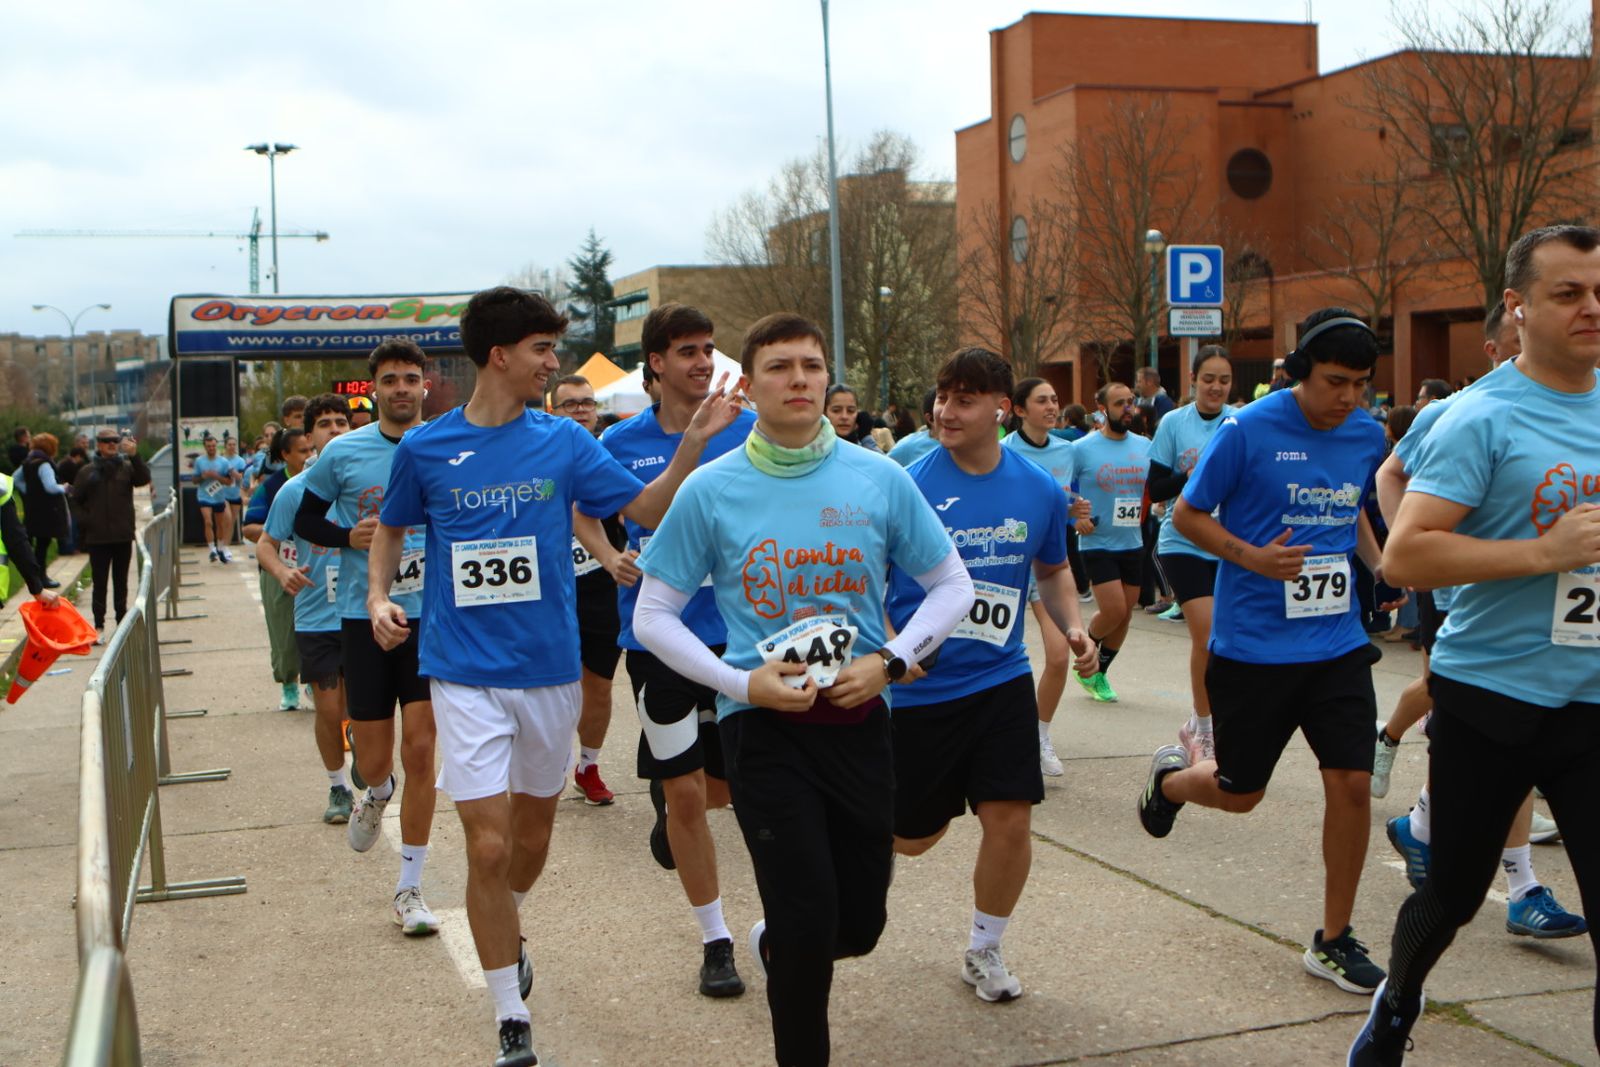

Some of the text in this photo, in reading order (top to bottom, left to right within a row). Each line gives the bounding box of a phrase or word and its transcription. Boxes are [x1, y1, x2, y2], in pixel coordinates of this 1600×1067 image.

[1180, 253, 1212, 298] P
[336, 381, 374, 394] 11:02
[450, 484, 544, 519] Tormes
[784, 541, 864, 569] contra
[461, 556, 532, 588] 336
[788, 570, 867, 597] el ictus
[1292, 571, 1347, 602] 379
[961, 598, 1011, 630] 00
[1563, 586, 1600, 624] 2
